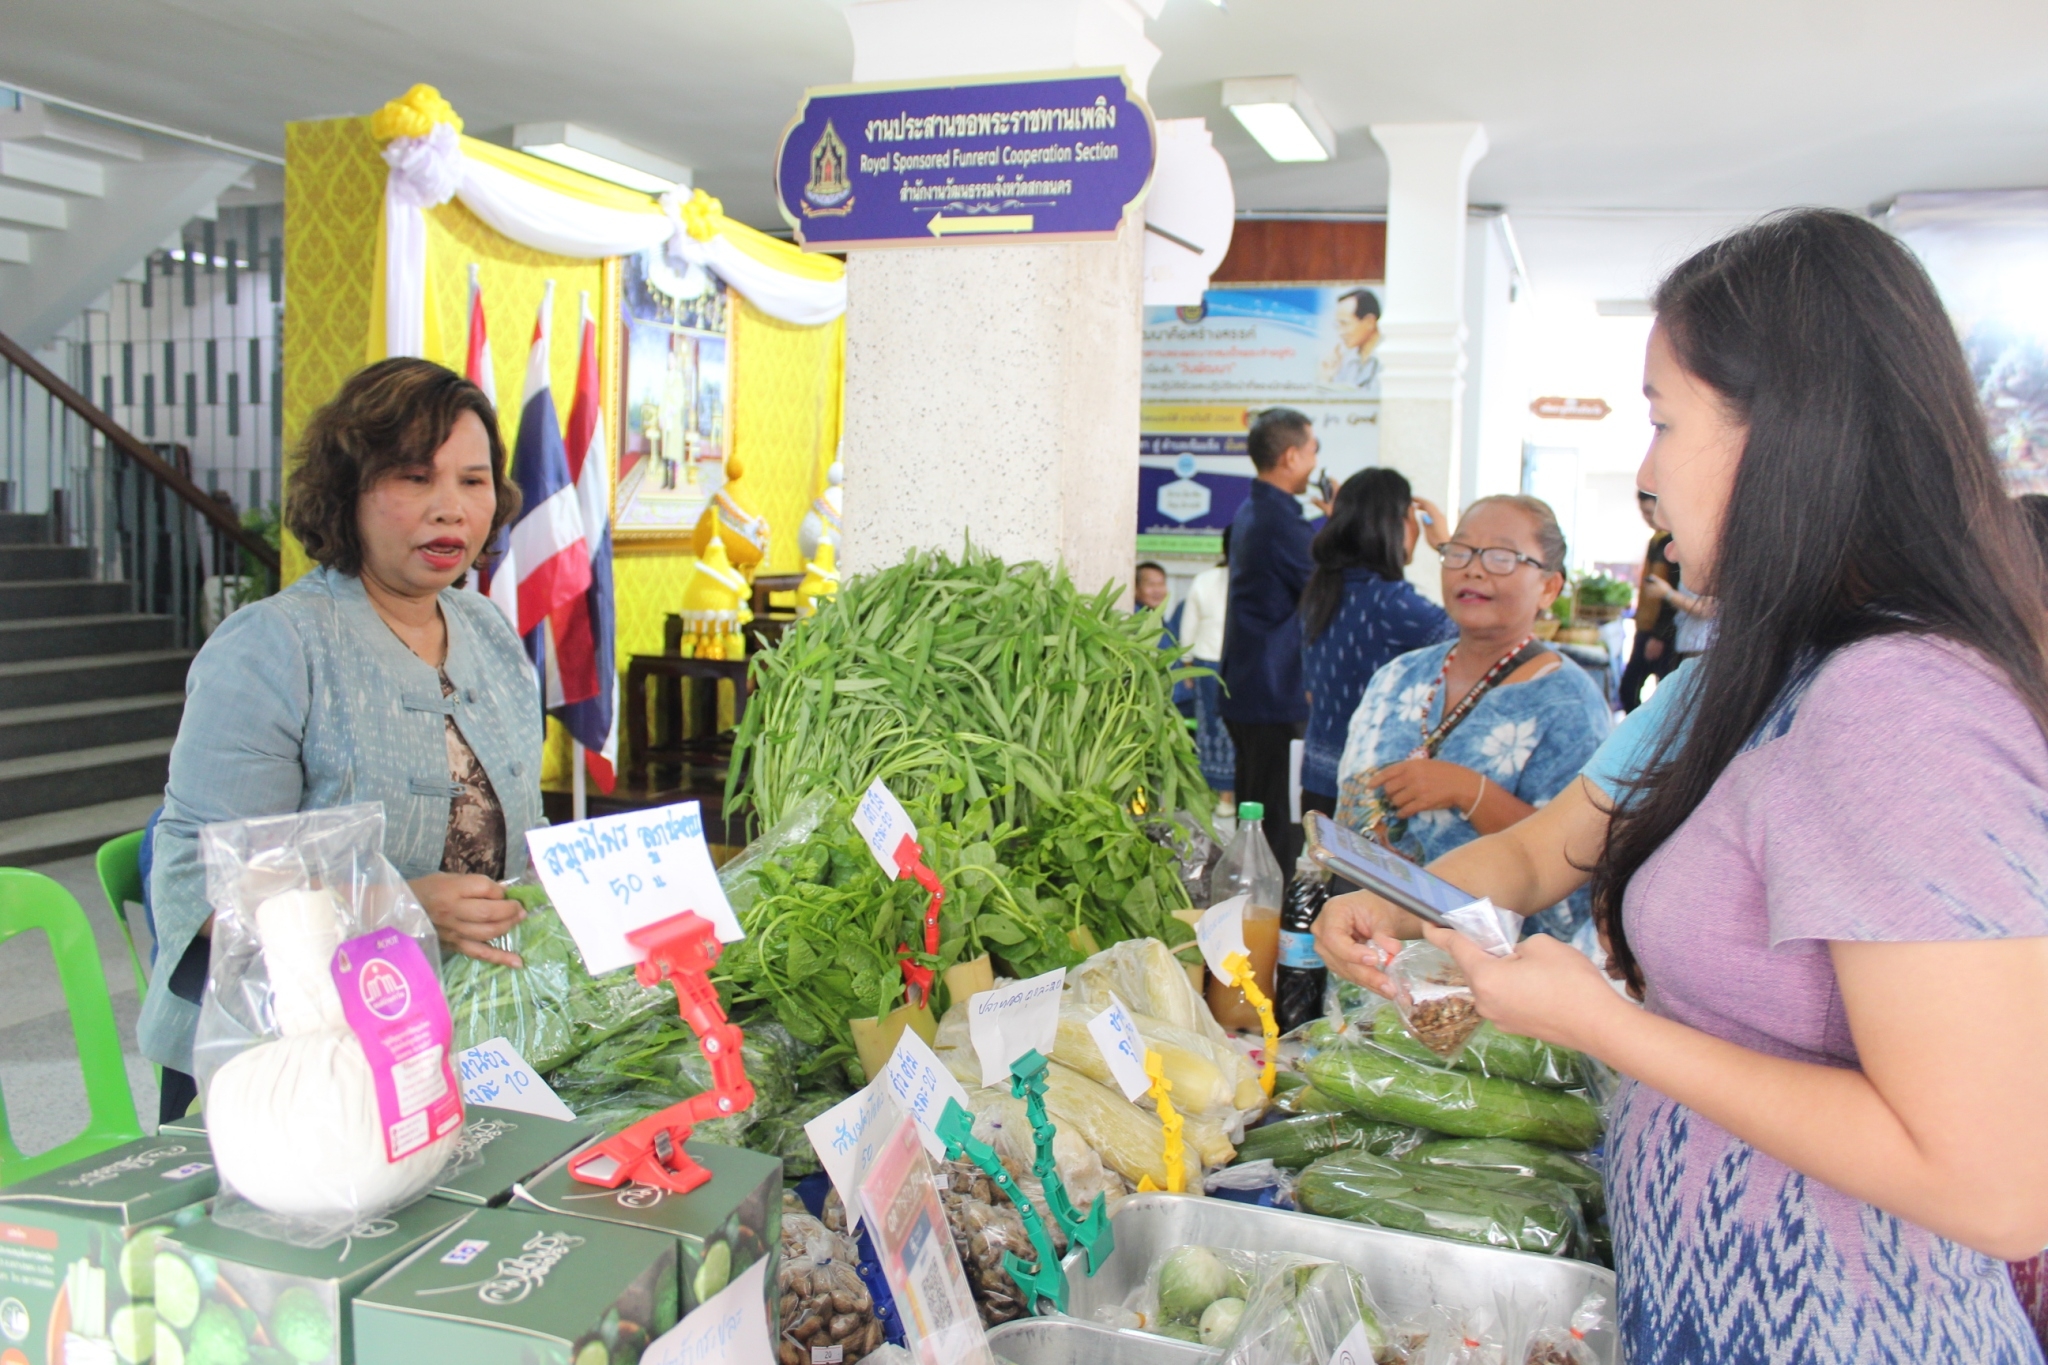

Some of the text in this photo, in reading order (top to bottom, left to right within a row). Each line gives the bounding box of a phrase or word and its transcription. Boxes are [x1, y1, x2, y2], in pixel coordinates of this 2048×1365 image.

[865, 96, 1116, 142] งานประสานขอพระราชทานเพลิง
[860, 141, 1118, 176] Royal Sponsored Funreral Cooperation Section
[900, 174, 1072, 202] สำนักงานวัฒนธรรมจังหวัดสกลนคร
[609, 873, 643, 905] 50
[505, 1070, 529, 1095] 10
[922, 1066, 937, 1092] 20
